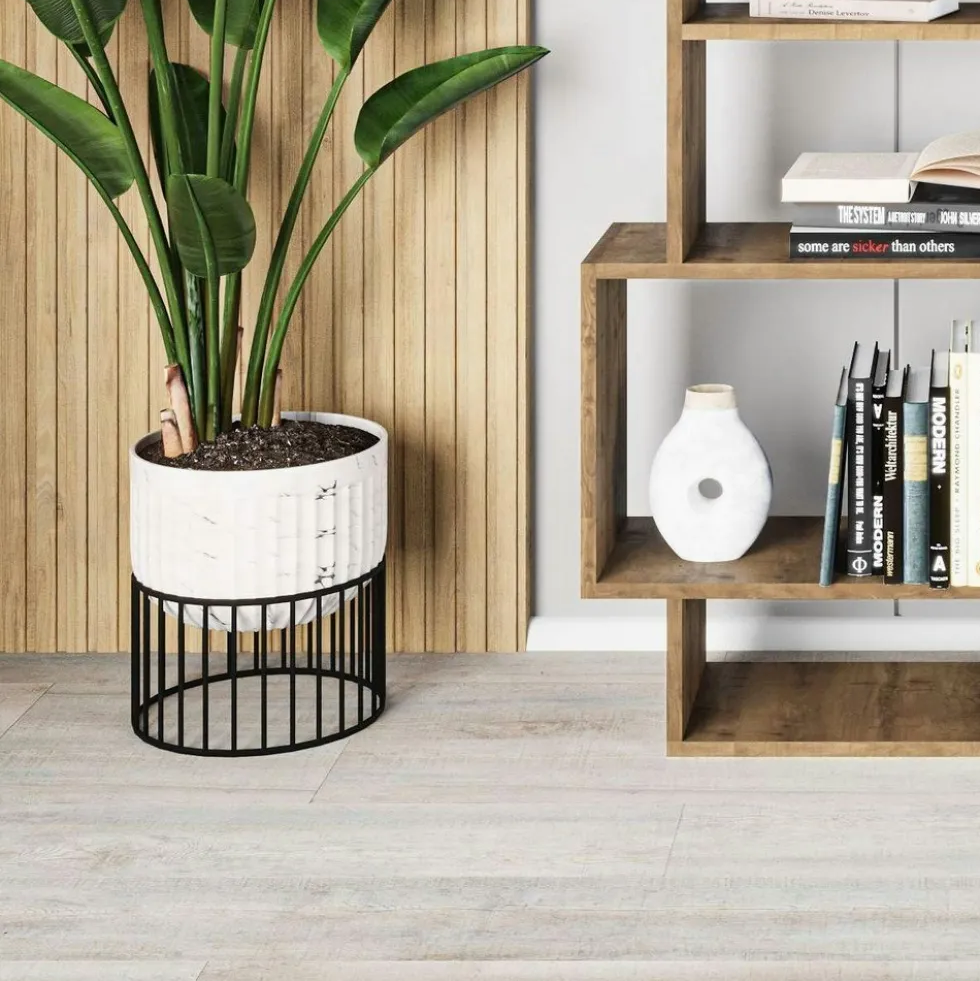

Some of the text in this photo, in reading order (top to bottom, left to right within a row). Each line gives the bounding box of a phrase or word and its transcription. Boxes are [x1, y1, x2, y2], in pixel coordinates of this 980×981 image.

[852, 206, 885, 225] SYSTEM
[940, 211, 957, 225] JOHN
[798, 240, 955, 253] some are sicker than others
[885, 410, 898, 482] Weltarchitektur
[931, 396, 947, 474] MODERN
[873, 495, 884, 568] MODERN
[887, 531, 895, 577] westermann
